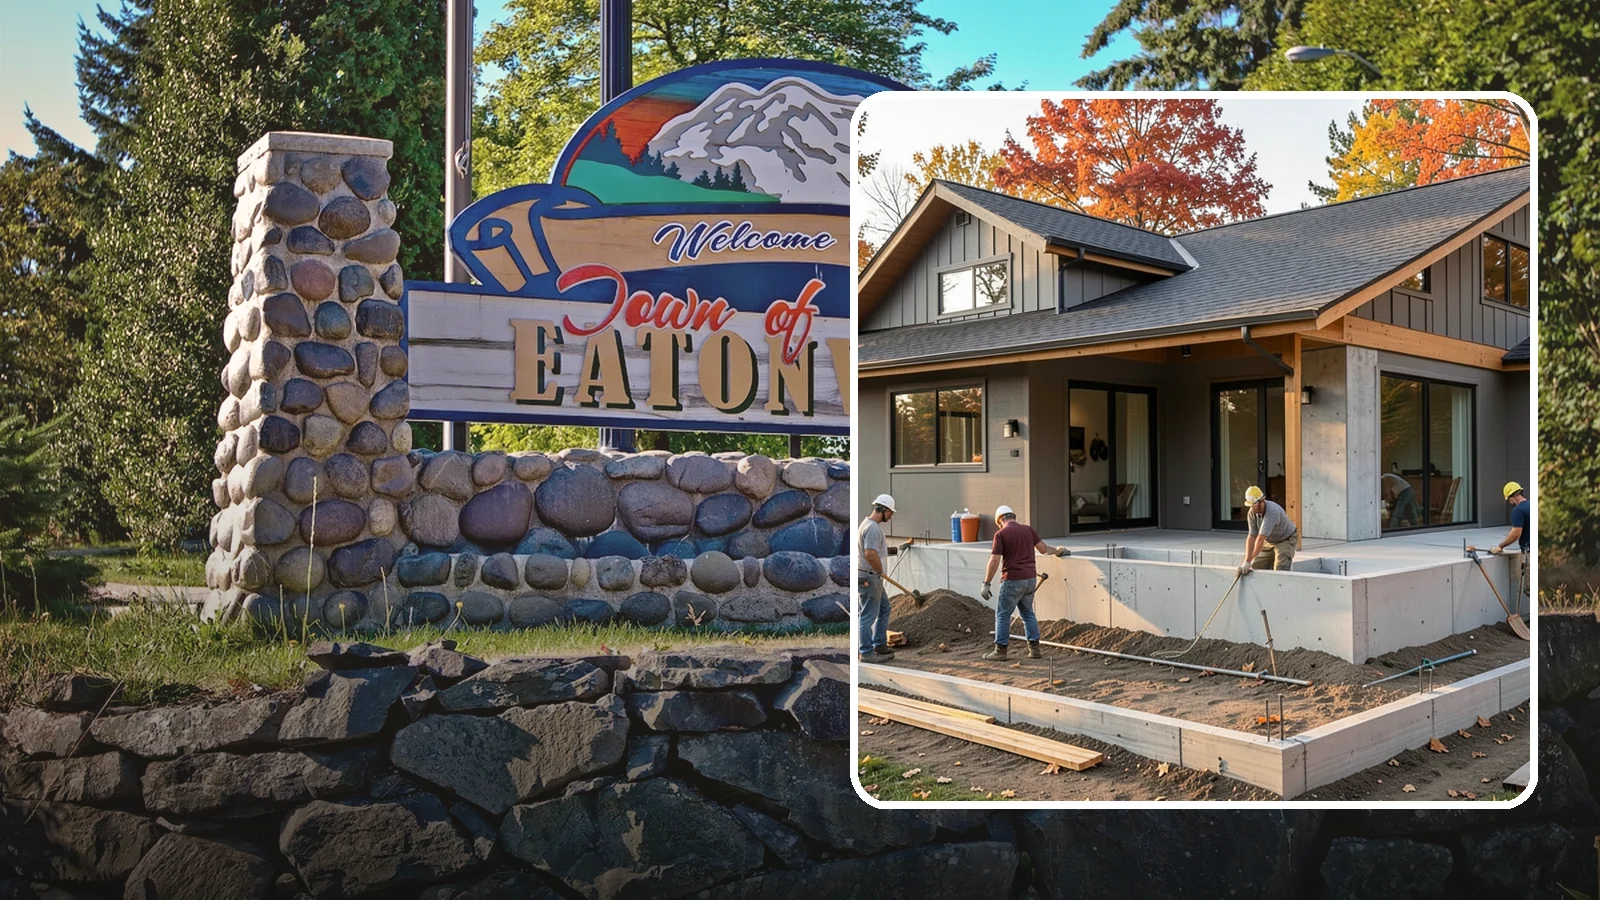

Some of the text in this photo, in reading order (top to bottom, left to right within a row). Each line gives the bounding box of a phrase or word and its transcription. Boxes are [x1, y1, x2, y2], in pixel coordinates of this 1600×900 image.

[653, 220, 837, 263] Welcome
[556, 264, 826, 364] Town of
